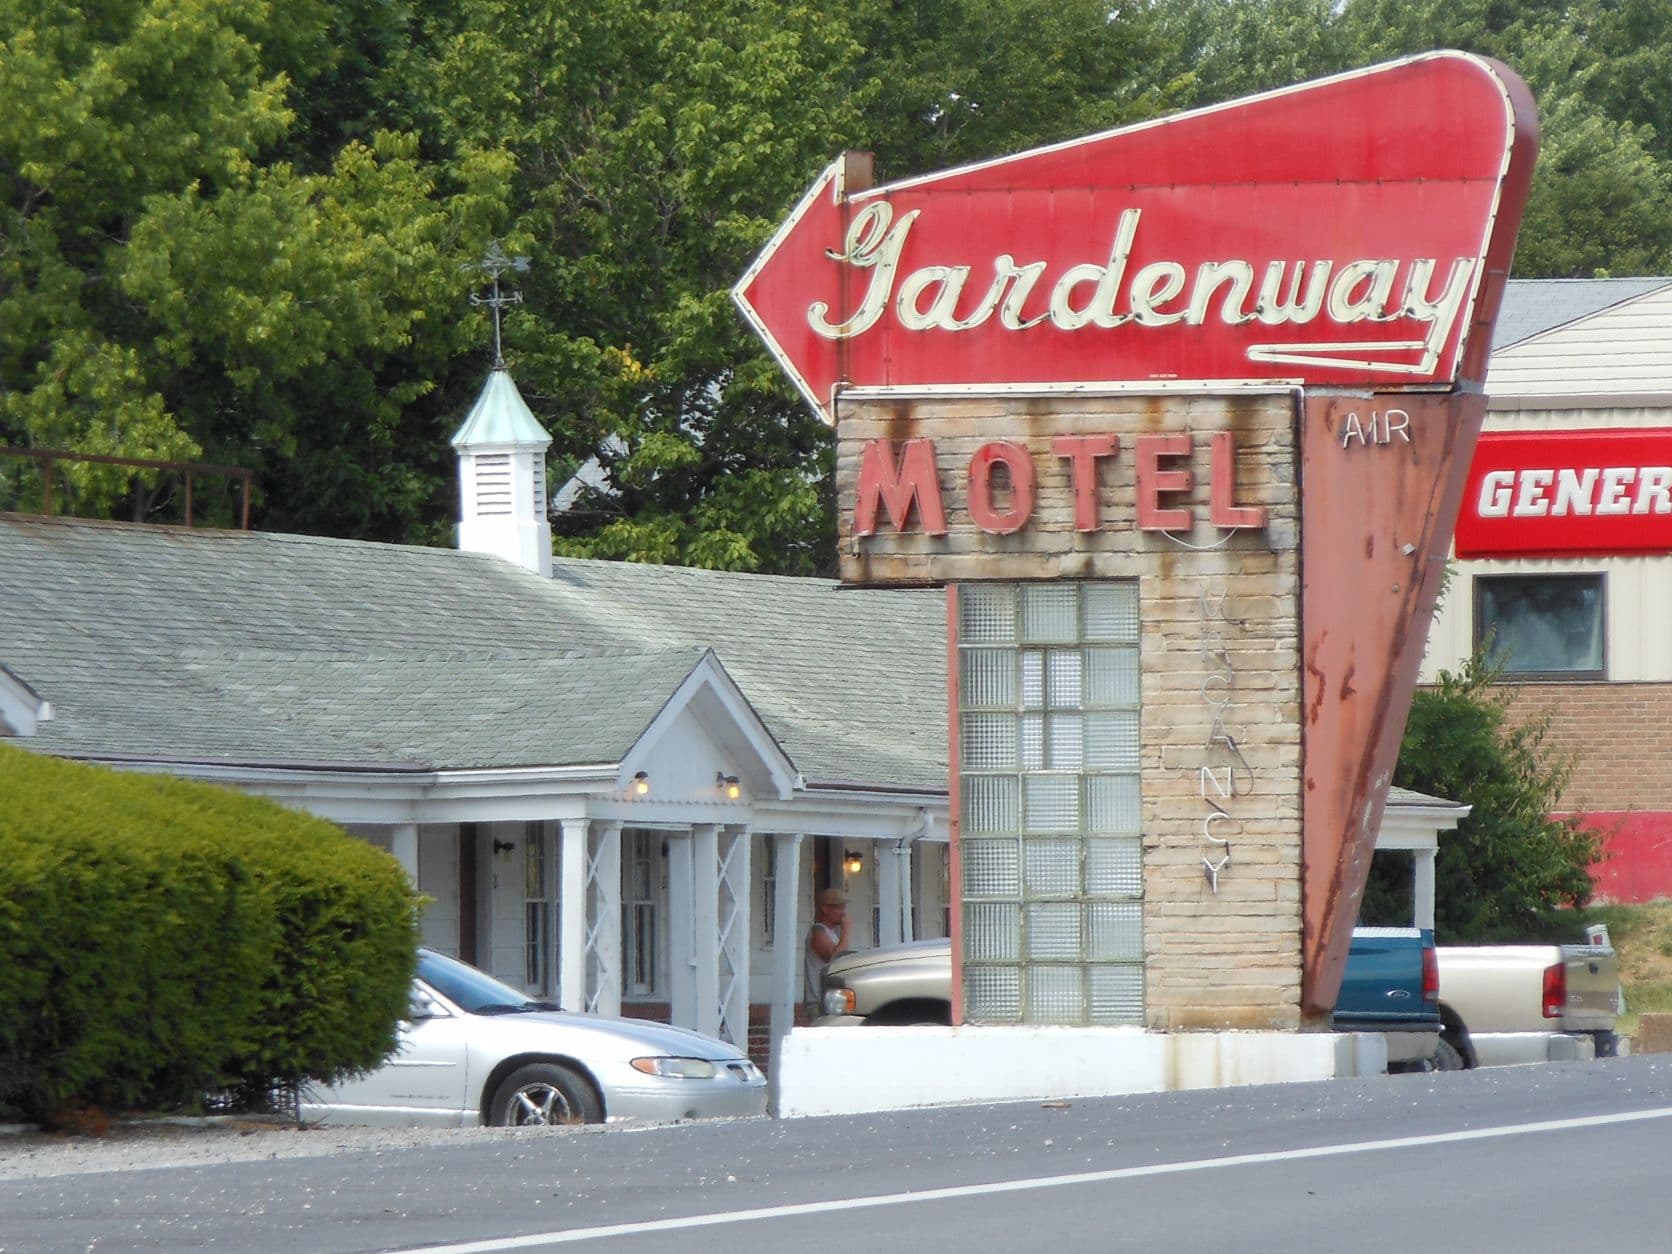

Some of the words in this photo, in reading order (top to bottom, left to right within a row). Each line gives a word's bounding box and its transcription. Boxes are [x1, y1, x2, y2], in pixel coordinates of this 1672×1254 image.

[807, 200, 1476, 376] Gardenway
[1343, 409, 1411, 449] AIR
[854, 432, 1266, 536] MOTEL
[1478, 466, 1672, 517] GENER
